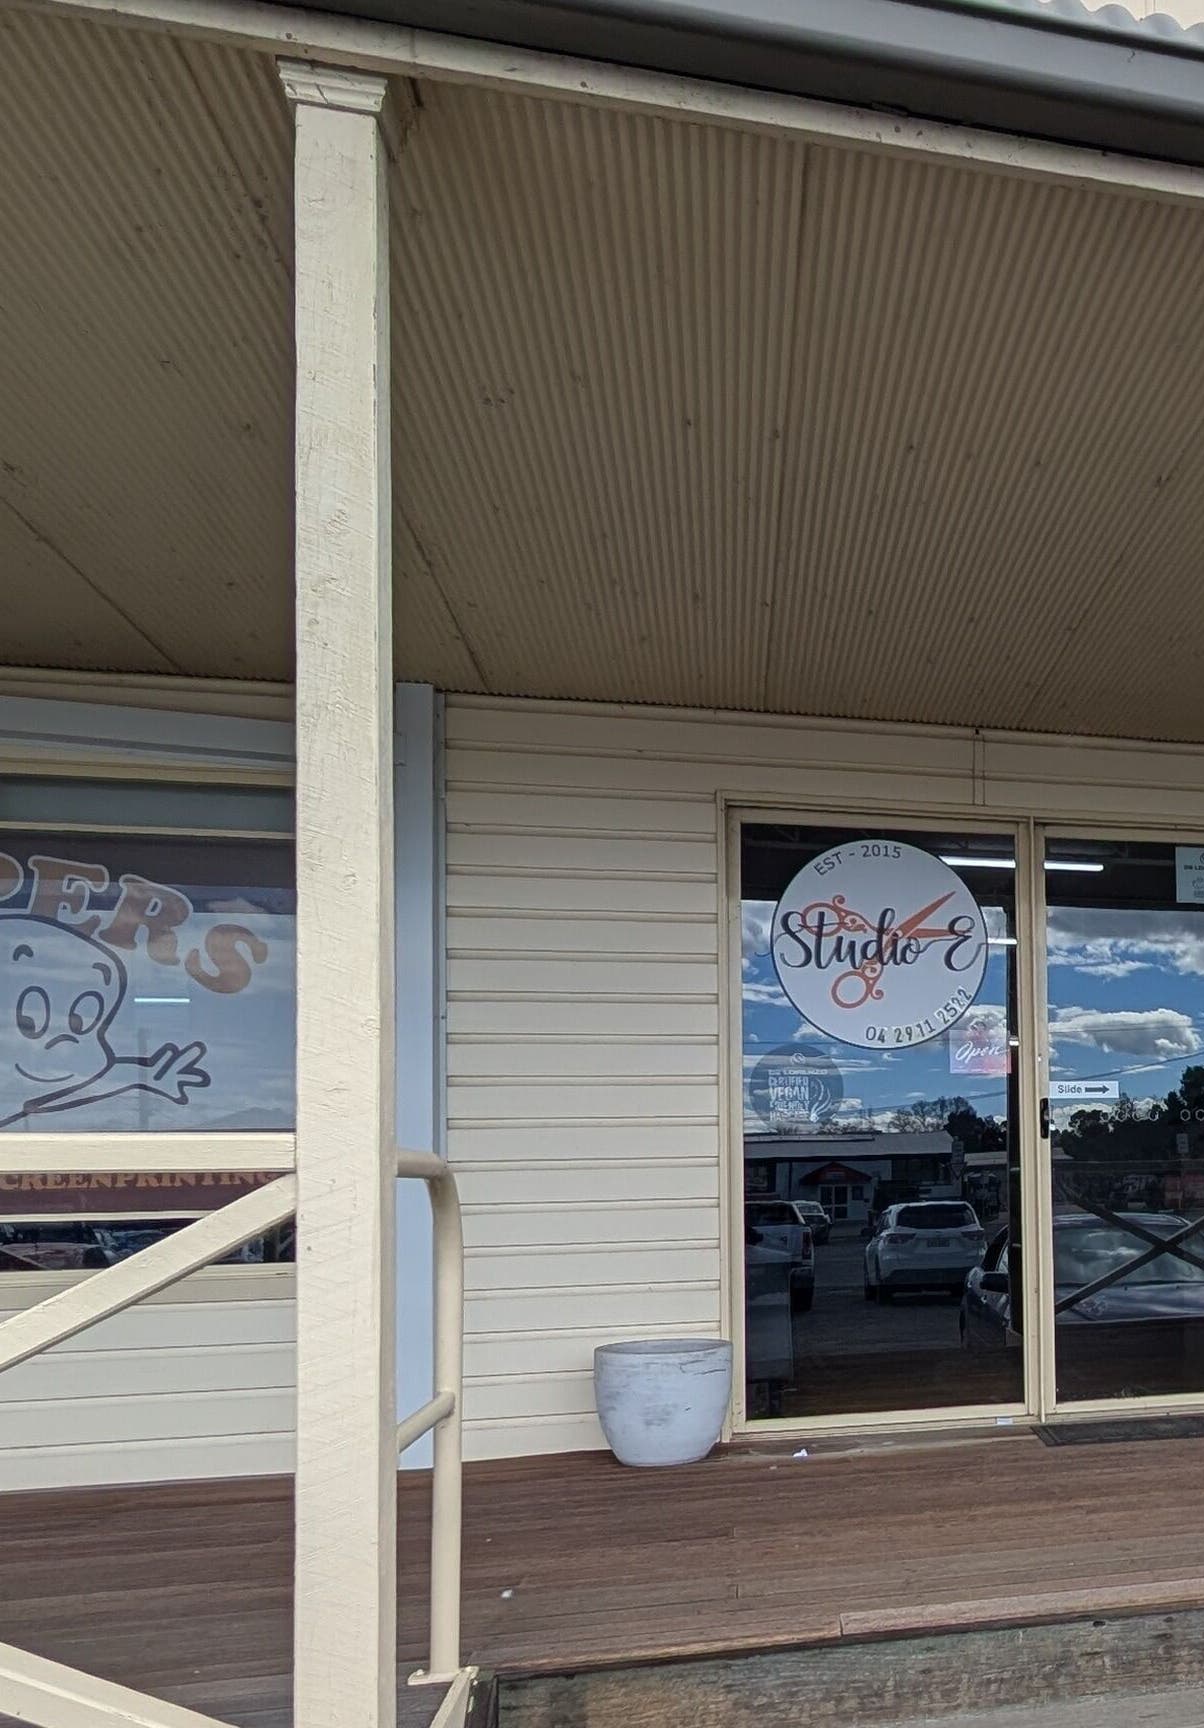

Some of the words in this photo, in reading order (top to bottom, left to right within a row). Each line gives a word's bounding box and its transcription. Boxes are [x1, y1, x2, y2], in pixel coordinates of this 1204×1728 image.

[813, 852, 843, 875] EST
[861, 844, 902, 859] 2015
[776, 907, 920, 970] Studio
[943, 915, 986, 972] E
[865, 1026, 886, 1043] 04
[937, 987, 972, 1024] 2522
[1057, 1084, 1083, 1094] Slide
